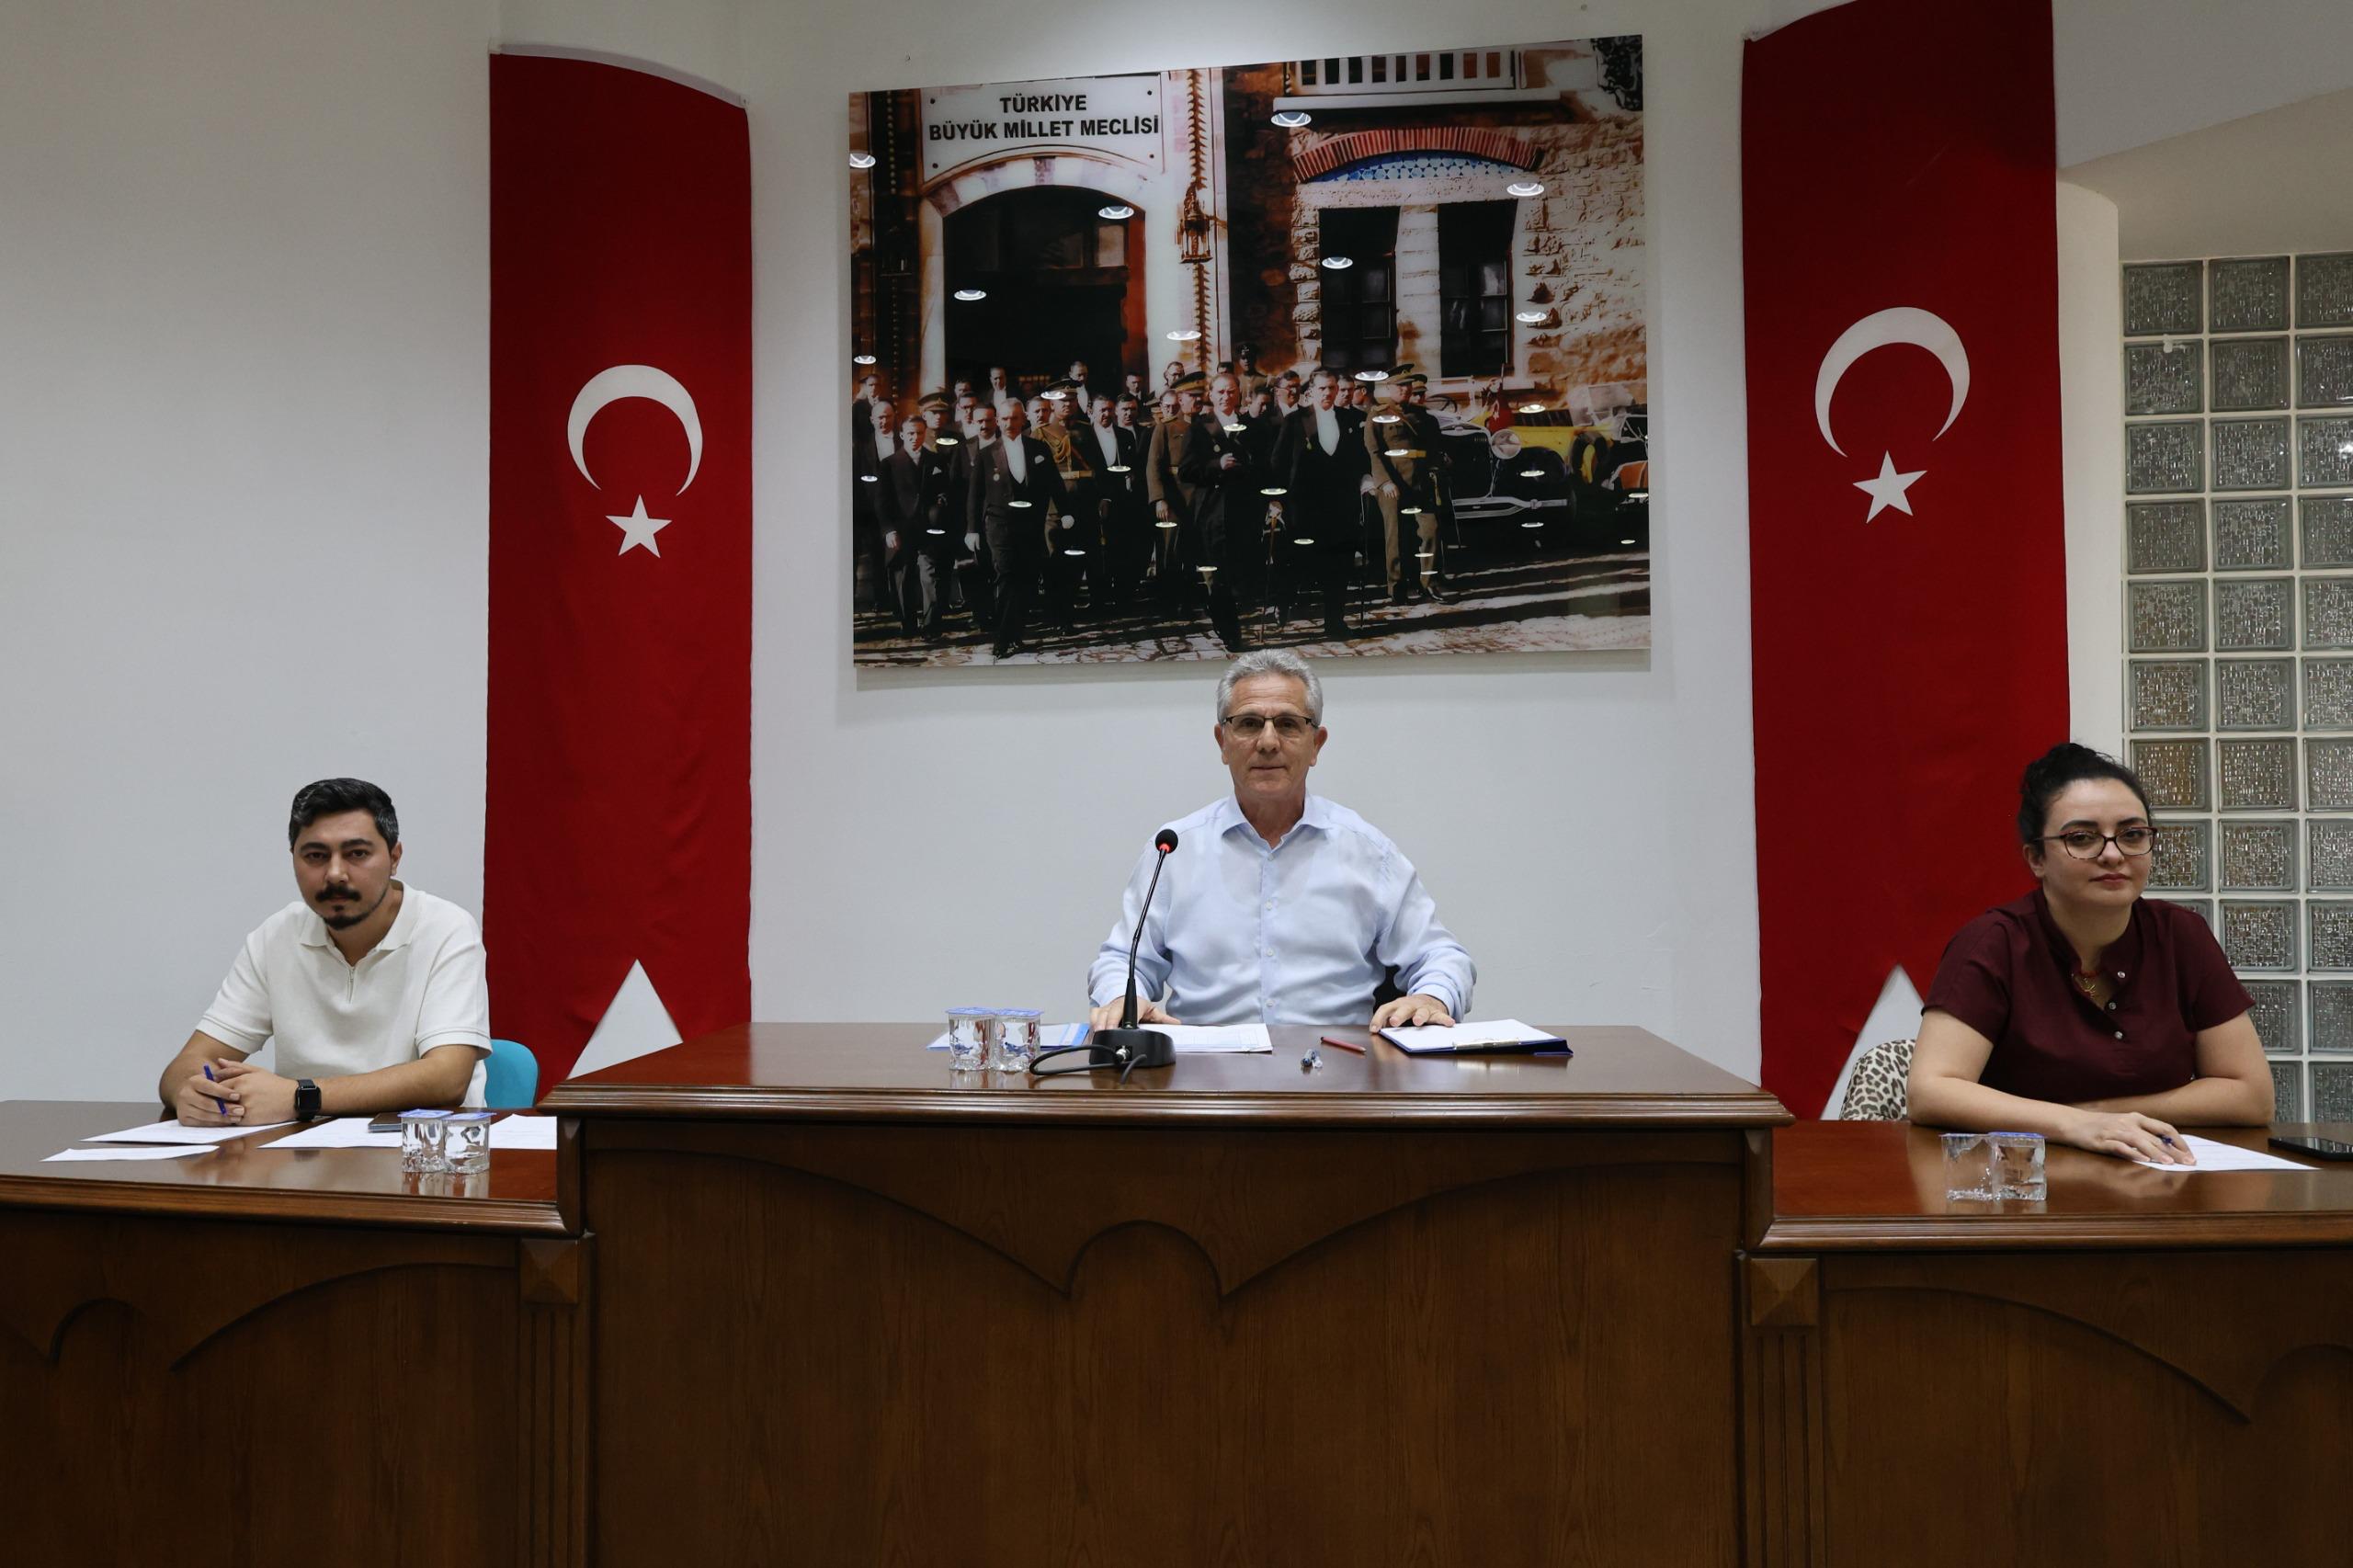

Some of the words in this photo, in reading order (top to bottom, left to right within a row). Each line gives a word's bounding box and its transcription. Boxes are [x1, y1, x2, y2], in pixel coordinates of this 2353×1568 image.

[999, 93, 1087, 113] TÜRKİYE
[929, 120, 998, 141] BÜYÜK
[1004, 119, 1074, 139] MİLLET
[1080, 115, 1160, 136] MECLİSİ
